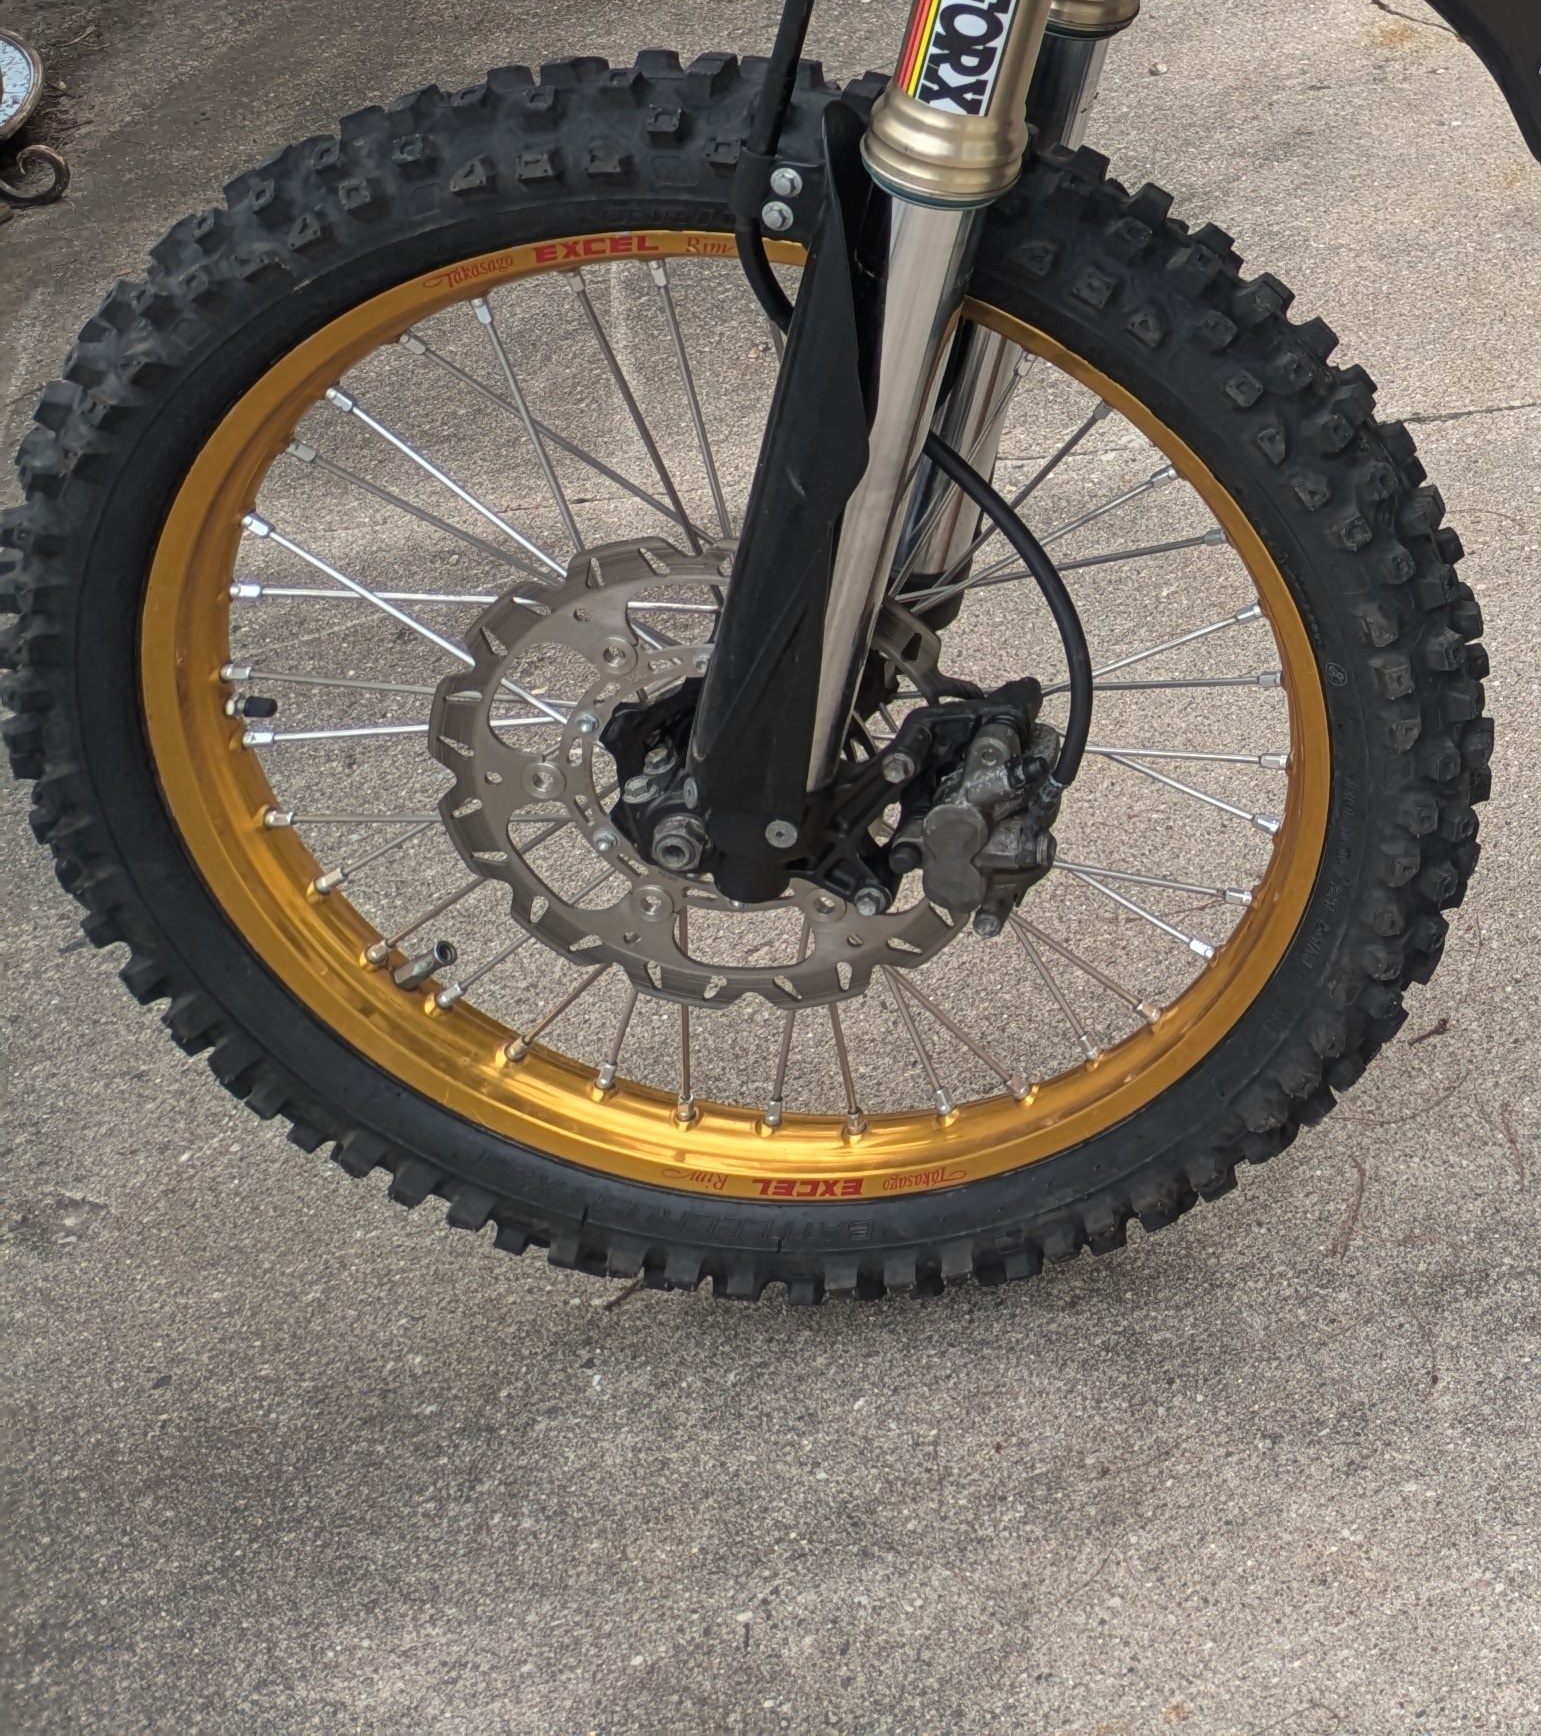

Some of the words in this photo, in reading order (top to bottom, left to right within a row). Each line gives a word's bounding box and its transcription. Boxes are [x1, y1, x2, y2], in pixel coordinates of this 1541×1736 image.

[423, 255, 514, 289] Takasago
[533, 236, 660, 264] EXCEL
[687, 236, 738, 254] Rim
[661, 1168, 730, 1191] Rim
[752, 1178, 865, 1198] EXCEL
[882, 1166, 968, 1191] Takasago
